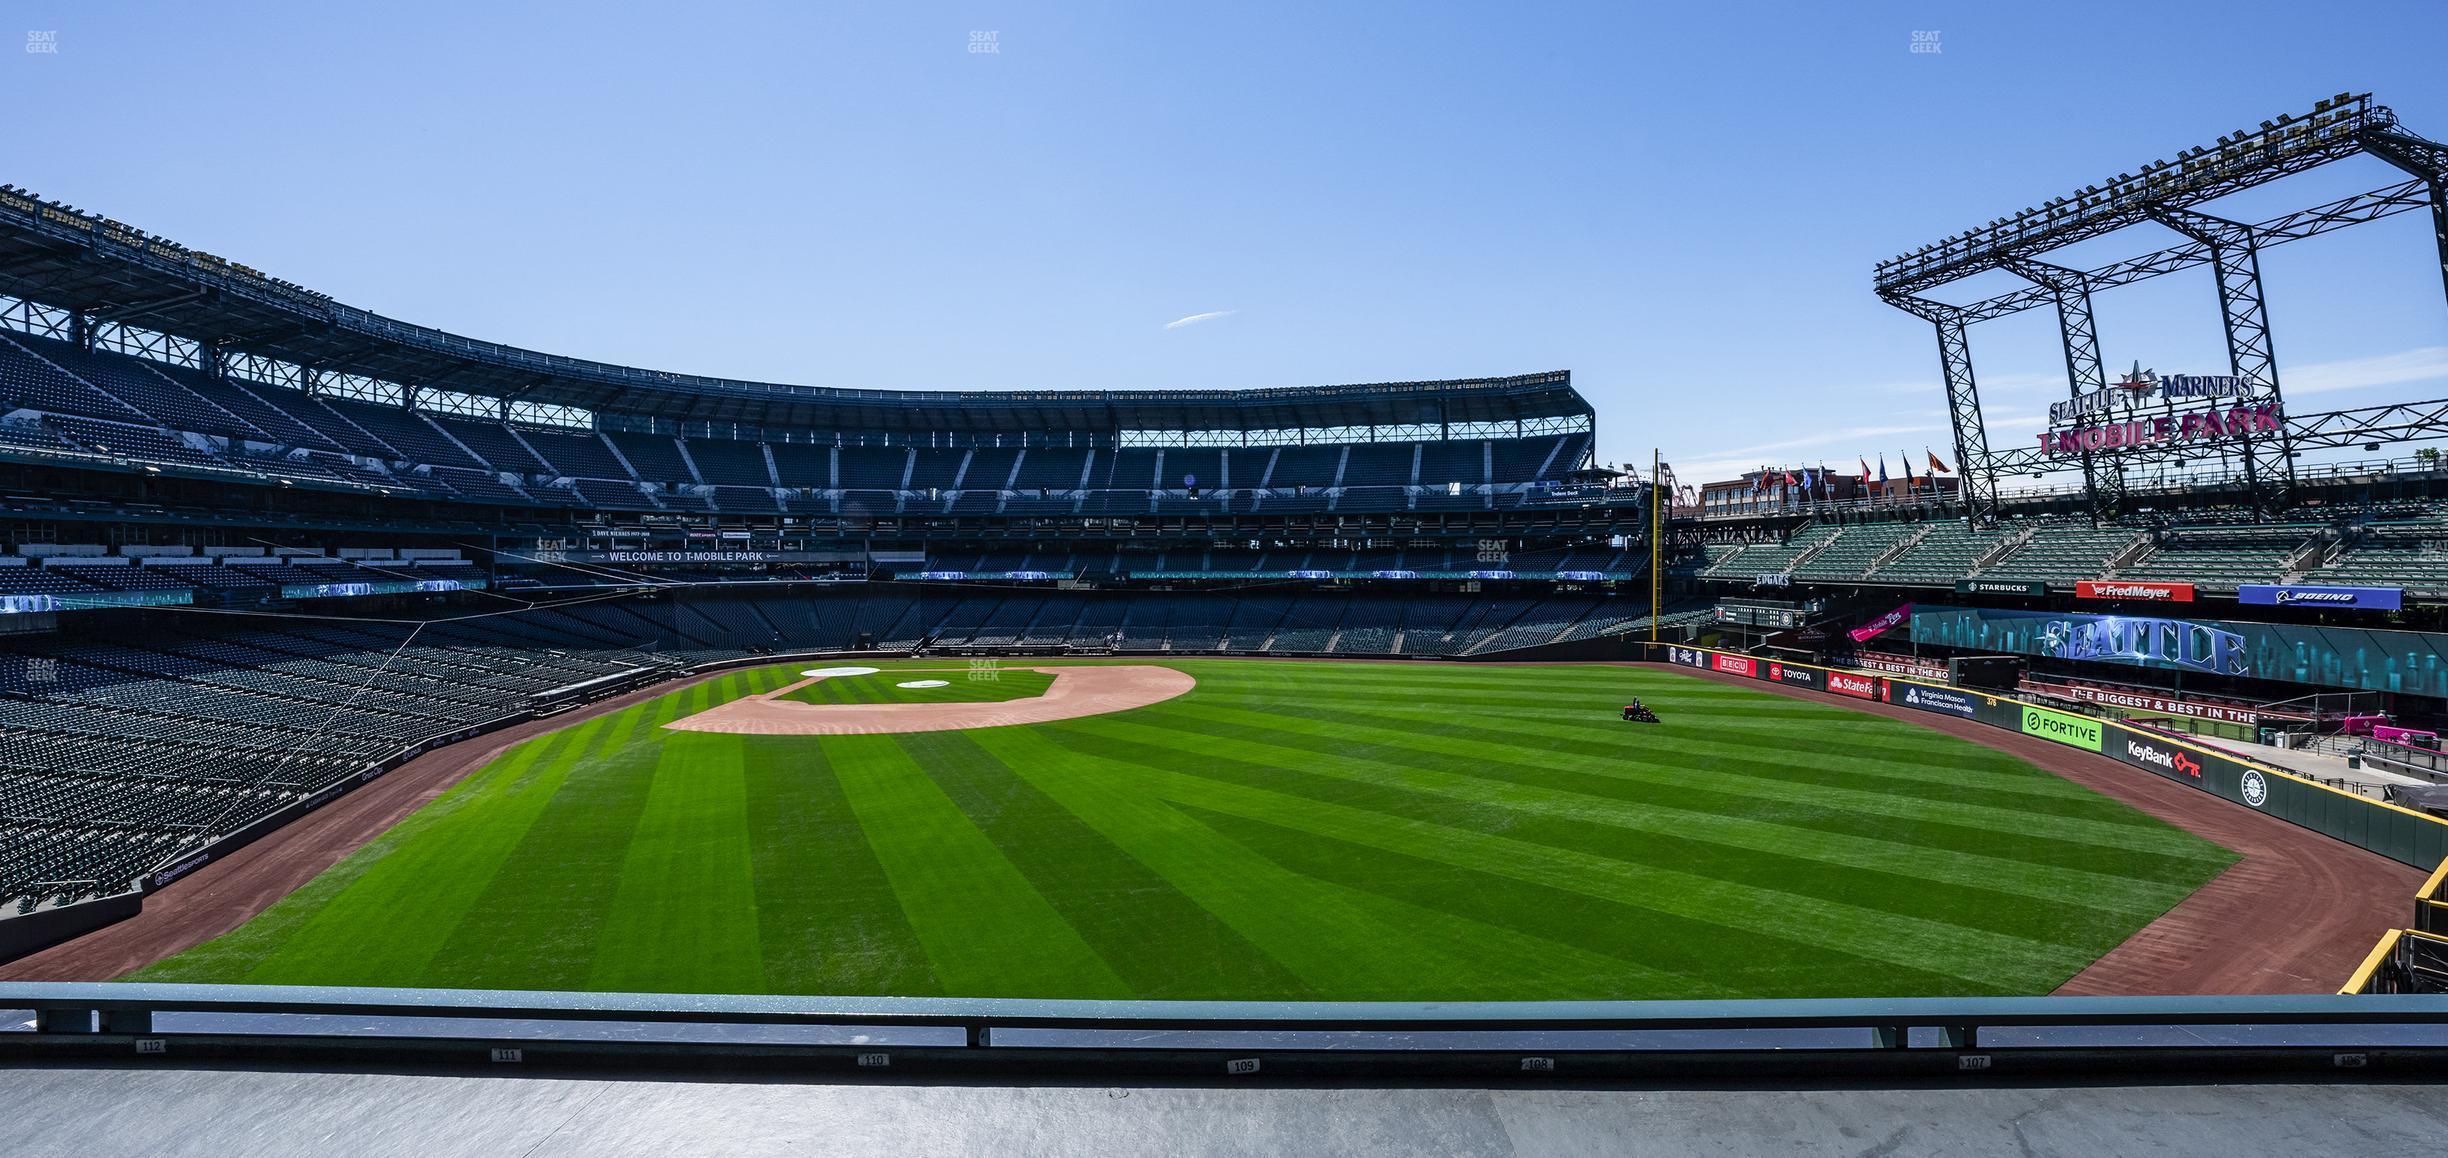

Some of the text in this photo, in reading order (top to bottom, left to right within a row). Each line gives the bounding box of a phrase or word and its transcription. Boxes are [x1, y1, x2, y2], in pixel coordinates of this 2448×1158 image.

[2160, 374, 2255, 398] MARINERS
[2037, 401, 2286, 455] T-MOBILE PARK
[609, 552, 763, 561] WELCOME TO T-MOBILE PARK
[1980, 583, 2027, 592] STARBUCKS
[2294, 592, 2354, 601] BOEING
[1783, 669, 1811, 681] TOYOTA
[1886, 664, 1905, 673] BEST
[1907, 666, 1916, 675] IN
[1918, 668, 1933, 677] THE
[1921, 690, 1966, 703] Virginia Mason
[1921, 698, 1973, 713] Franciscan Health
[2097, 692, 2151, 708] BIGGEST
[2154, 700, 2164, 710] &
[2168, 702, 2204, 716] BEST
[2207, 709, 2223, 719] IN
[2227, 711, 2256, 723] THE
[2043, 718, 2096, 742] FORTIVE
[2128, 740, 2173, 769] KeyBank
[1236, 1061, 1254, 1072] 109
[1529, 1059, 1547, 1070] 108
[1968, 1058, 1985, 1068] 107
